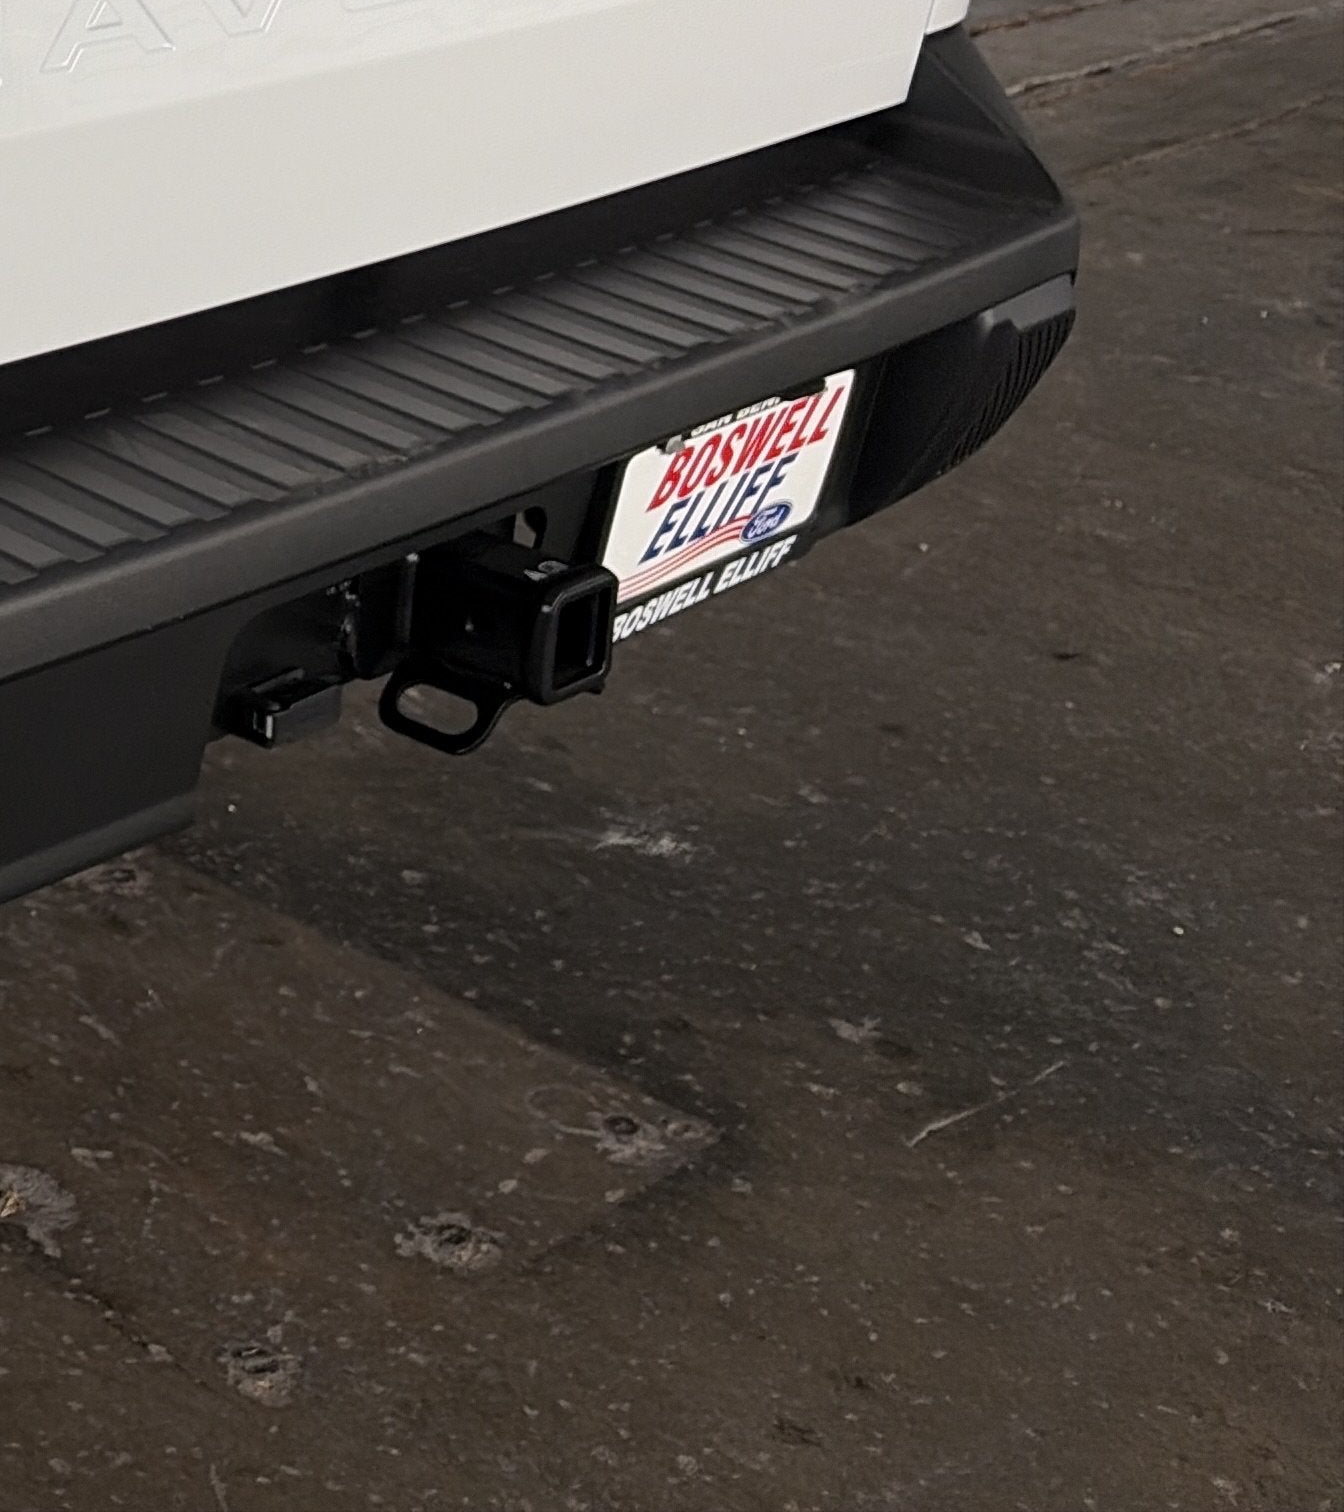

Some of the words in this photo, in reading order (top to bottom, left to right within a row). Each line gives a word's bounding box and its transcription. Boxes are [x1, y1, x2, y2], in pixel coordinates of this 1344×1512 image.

[645, 387, 845, 513] BOSWELL
[637, 451, 799, 566] ELLIFF
[746, 506, 786, 539] Ford
[612, 571, 714, 643] BOSWELL
[714, 535, 797, 594] ELLIFF
